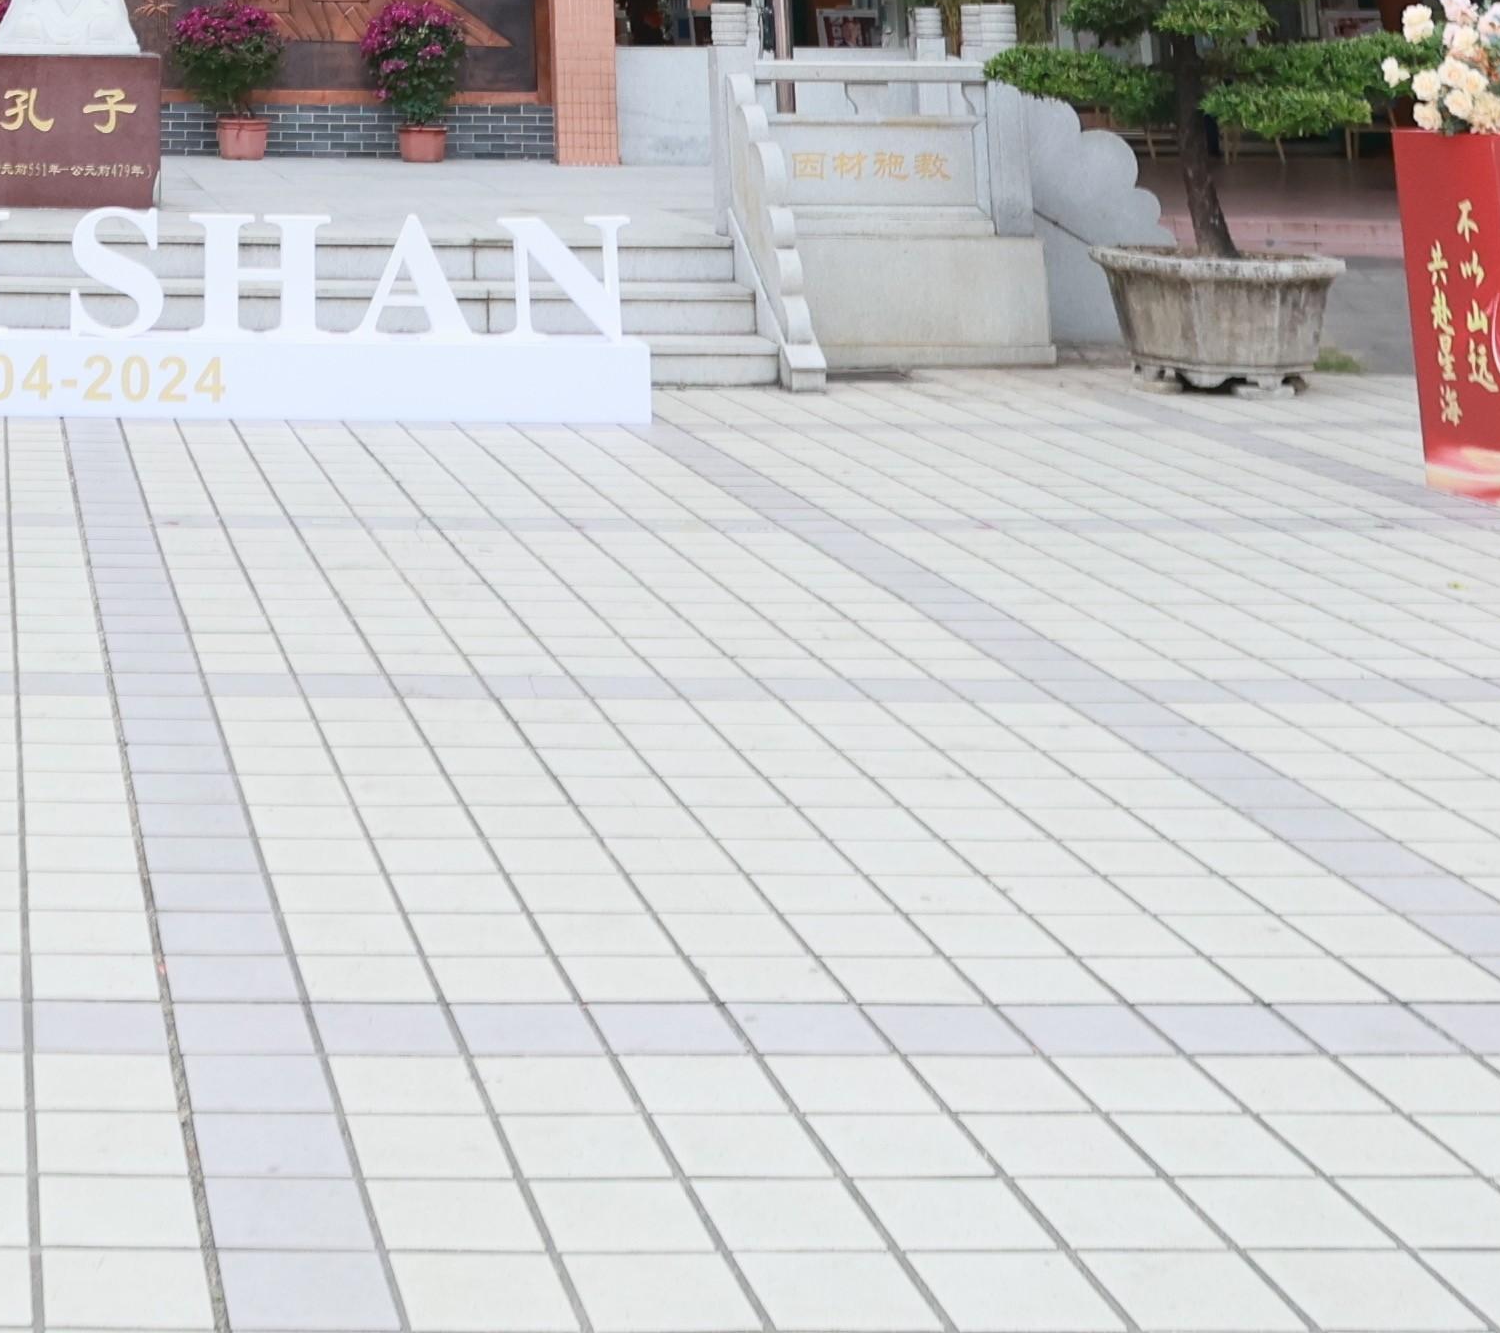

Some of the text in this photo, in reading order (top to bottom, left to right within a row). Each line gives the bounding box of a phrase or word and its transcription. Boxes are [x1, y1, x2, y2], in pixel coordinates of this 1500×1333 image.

[0, 88, 137, 134] 孔子
[1425, 238, 1464, 428] 共赴星海
[1456, 198, 1500, 394] 不以山远
